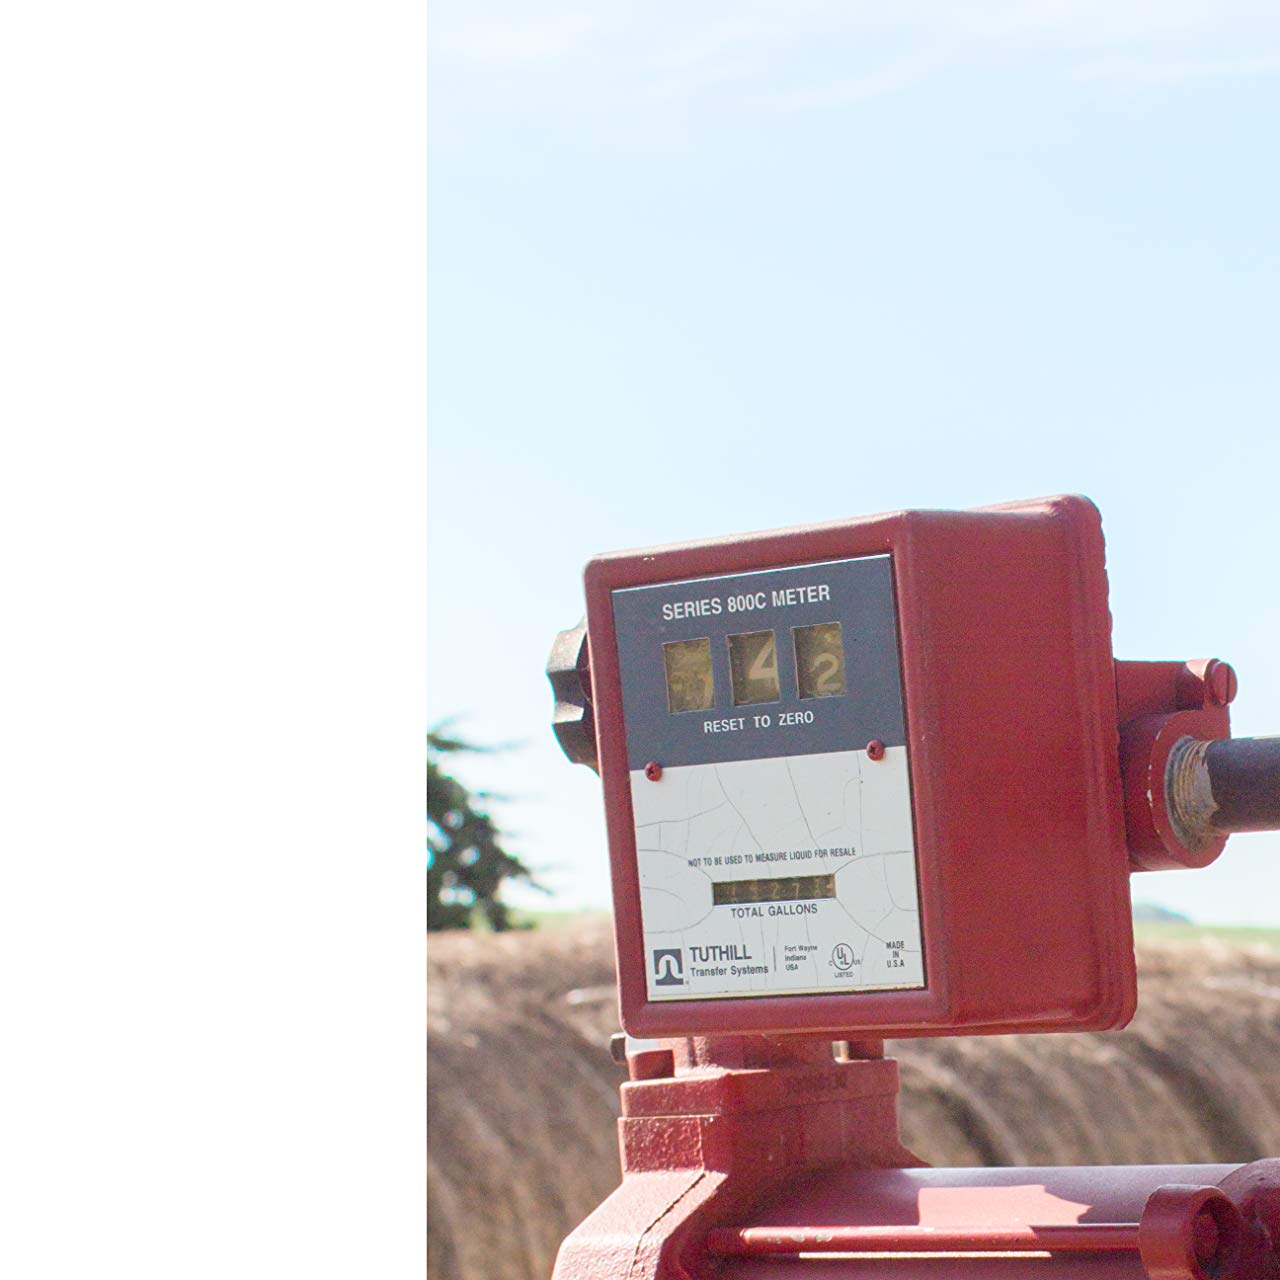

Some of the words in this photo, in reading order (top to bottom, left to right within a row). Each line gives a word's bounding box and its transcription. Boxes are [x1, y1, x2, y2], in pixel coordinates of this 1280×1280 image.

[662, 598, 722, 621] SERIES
[727, 592, 765, 612] 800C
[772, 585, 830, 607] METER
[813, 652, 842, 691] 2
[703, 717, 745, 733] RESET
[754, 715, 772, 728] TO
[778, 711, 814, 726] ZERO
[688, 858, 702, 867] NOT
[703, 857, 712, 866] TO
[714, 856, 723, 865] BE
[724, 855, 743, 865] USED
[744, 854, 753, 864] TO
[755, 852, 788, 862] MEASURE
[789, 850, 813, 860] LIQUID
[814, 849, 828, 858] FOR
[830, 847, 856, 857] RESALE
[731, 907, 764, 918] TOTAL
[768, 904, 818, 916] GALLONS
[689, 944, 752, 962] TUTHILL
[886, 941, 904, 949] MADE
[784, 954, 807, 962] Indiana
[690, 967, 727, 977] Transfer
[730, 965, 769, 977] Systems
[785, 963, 798, 971] USA
